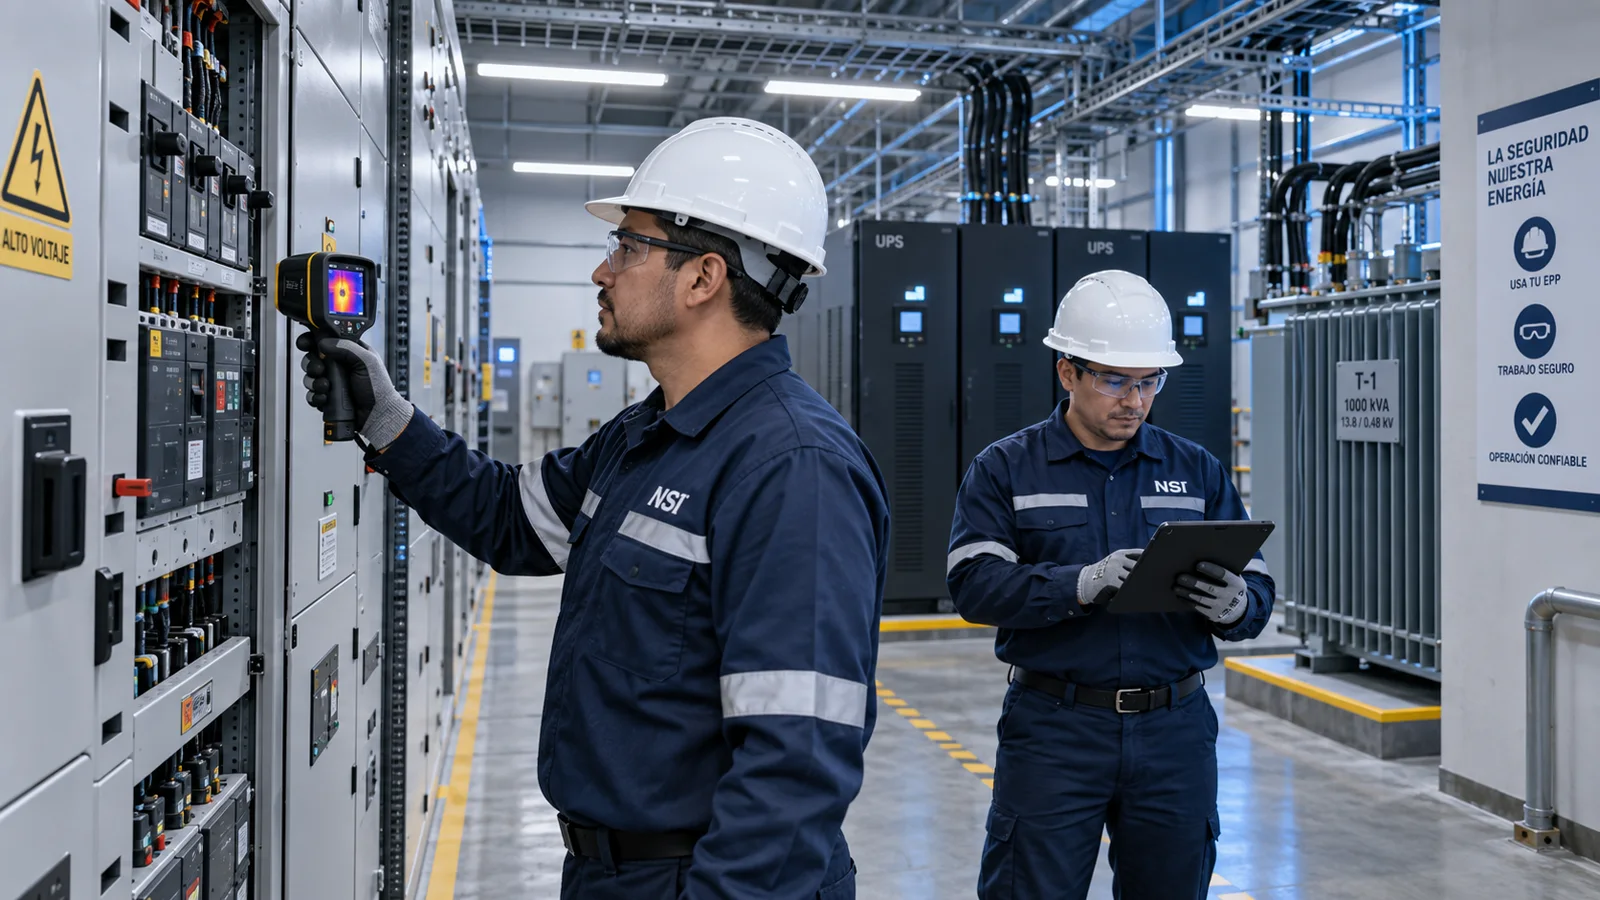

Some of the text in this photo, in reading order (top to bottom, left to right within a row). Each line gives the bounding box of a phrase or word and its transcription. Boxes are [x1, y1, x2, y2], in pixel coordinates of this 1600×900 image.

[1487, 125, 1589, 165] LA SEGURIDAD
[1487, 177, 1546, 206] ENERGÍA
[2, 228, 69, 265] ALTO VOLTAJE
[875, 234, 904, 249] UPS
[1087, 241, 1114, 255] UPS
[1510, 273, 1562, 290] USA TU EPP
[1497, 362, 1575, 376] TRABAJO SEGURO
[1354, 371, 1376, 391] T-1
[1344, 397, 1390, 412] 1000 kVA
[1341, 416, 1358, 428] 13.8
[1363, 416, 1381, 428] 0.48
[1488, 451, 1588, 468] OPERACIÓN CONFIABLE
